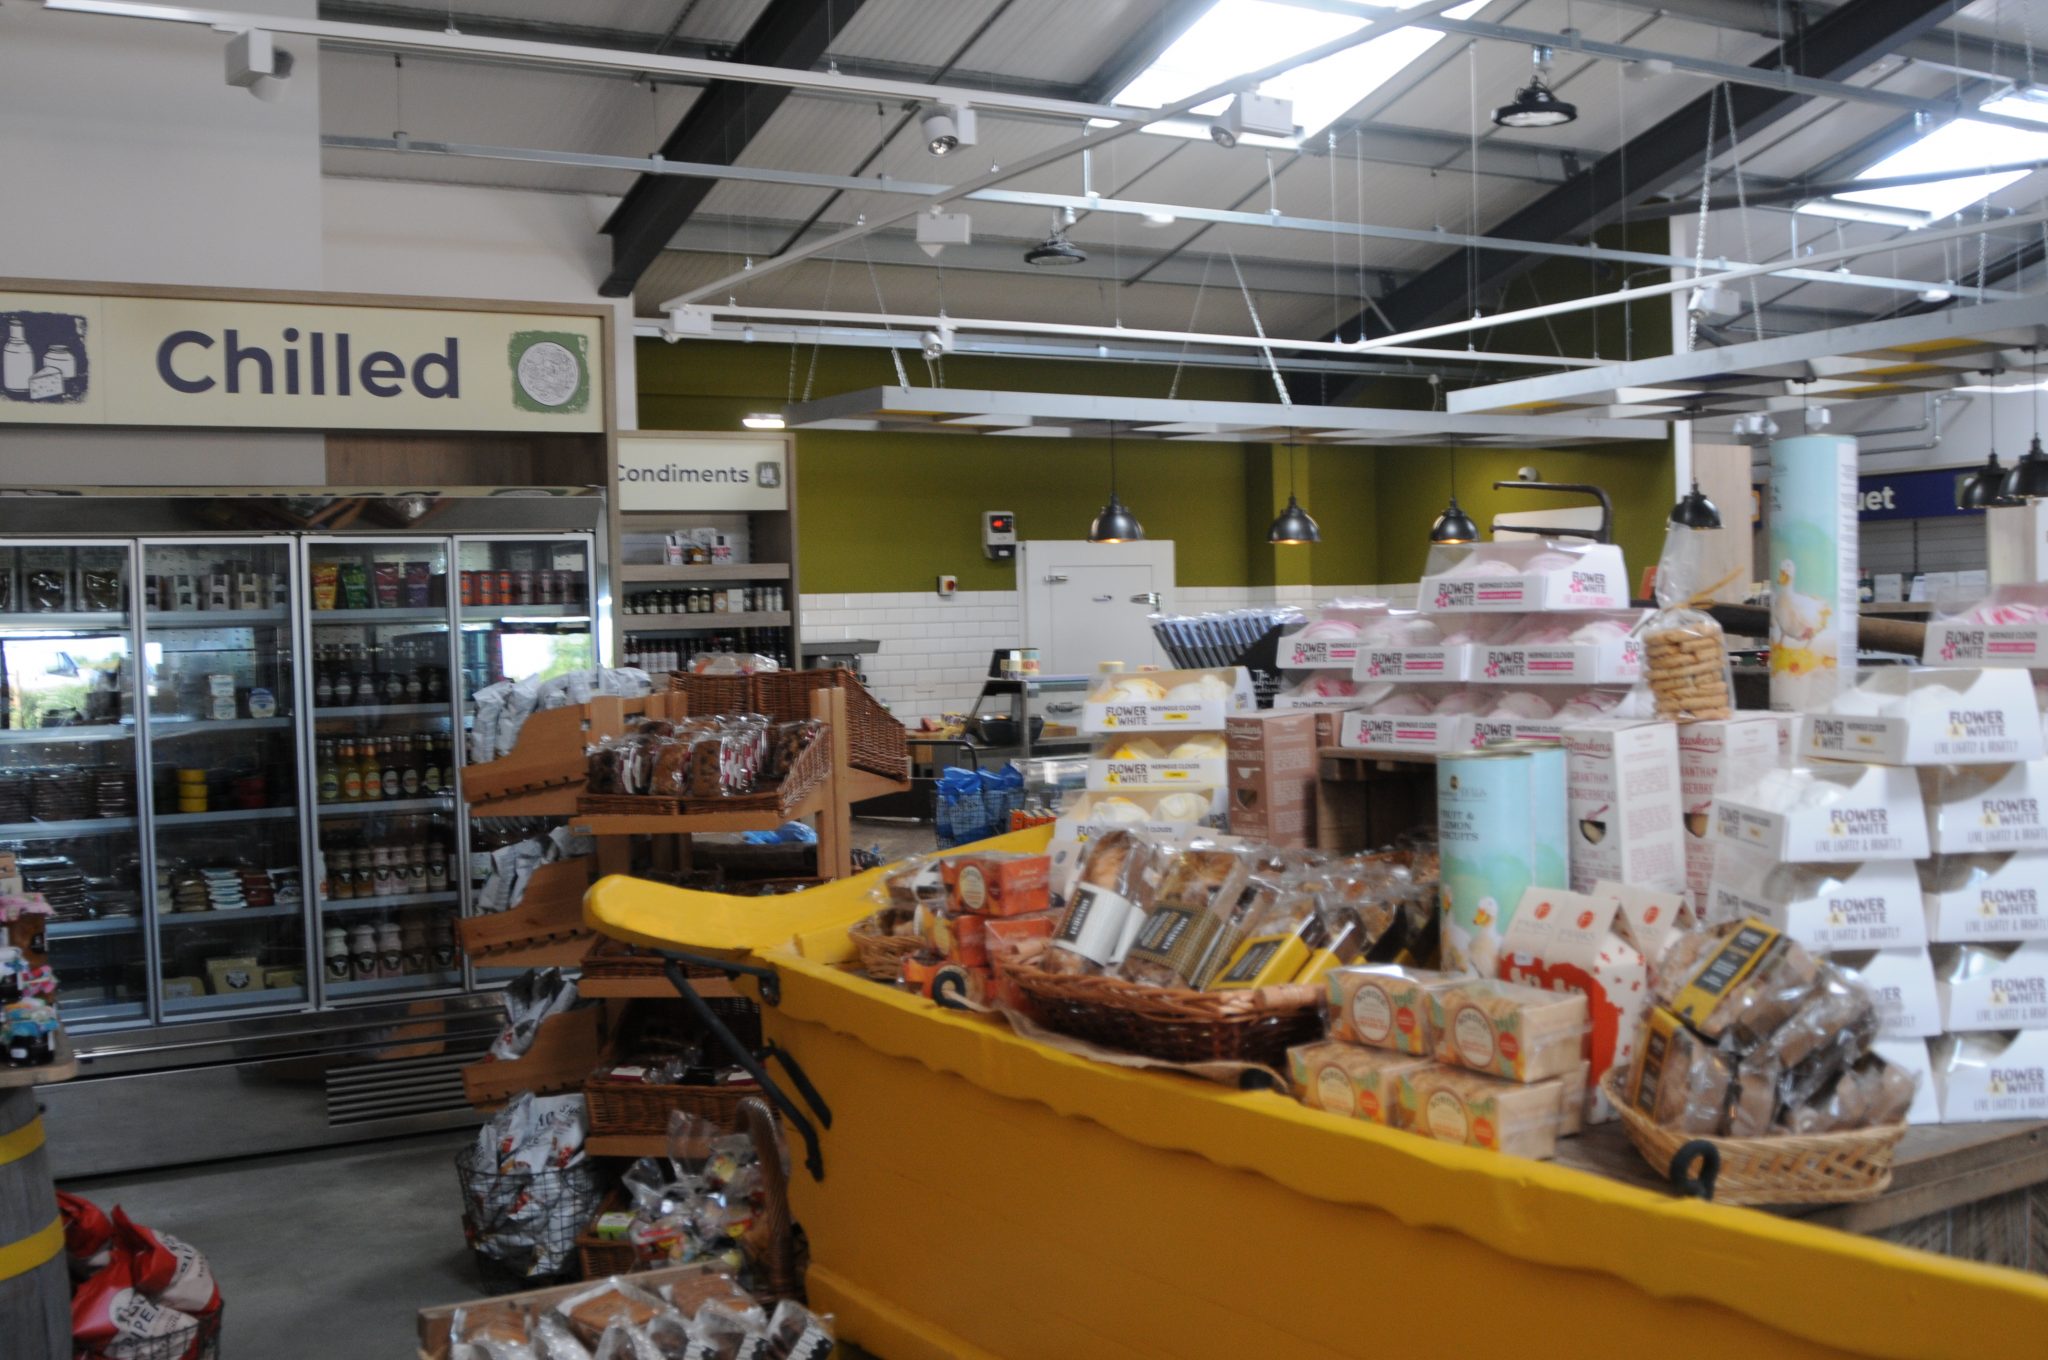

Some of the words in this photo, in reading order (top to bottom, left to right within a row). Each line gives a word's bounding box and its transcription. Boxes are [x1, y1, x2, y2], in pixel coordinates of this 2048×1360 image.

[156, 327, 460, 399] Chilled
[1572, 571, 1605, 584] FLOWER
[1438, 582, 1474, 594] FLOWER
[1449, 595, 1474, 606] WHITE
[1945, 631, 1984, 645] FLOWER
[1295, 643, 1326, 653] FLOWER
[1955, 646, 1984, 658] WHITE
[1371, 653, 1402, 664] FLOWER
[1488, 652, 1524, 664] FLOWER
[1499, 665, 1525, 676] WHITE
[1105, 706, 1146, 717] FLOWER
[1949, 710, 2004, 725] FLOWER
[1118, 717, 1147, 726] WHITE
[1361, 720, 1392, 731] FLOWER
[1475, 723, 1511, 737] FLOWER
[1814, 720, 1844, 736] FLOWER
[1966, 724, 2005, 737] WHITE
[1679, 733, 1723, 746] awkens
[1108, 764, 1147, 774] FLOWER
[1119, 774, 1148, 783] WHITE
[1982, 798, 2038, 813] FLOWER
[1830, 809, 1887, 823] FLOWER
[2000, 813, 2039, 825] WHITE
[1848, 823, 1888, 835] WHITE
[1981, 889, 2037, 903] FLOWER
[1829, 898, 1885, 912] FLOWER
[1999, 902, 2038, 915] WHITE
[1846, 912, 1886, 924] WHITE
[1992, 978, 2046, 992] FLOWER
[2008, 991, 2047, 1003] WHITE
[1991, 1068, 2044, 1081] FLOWER
[2007, 1081, 2045, 1093] WHITE
